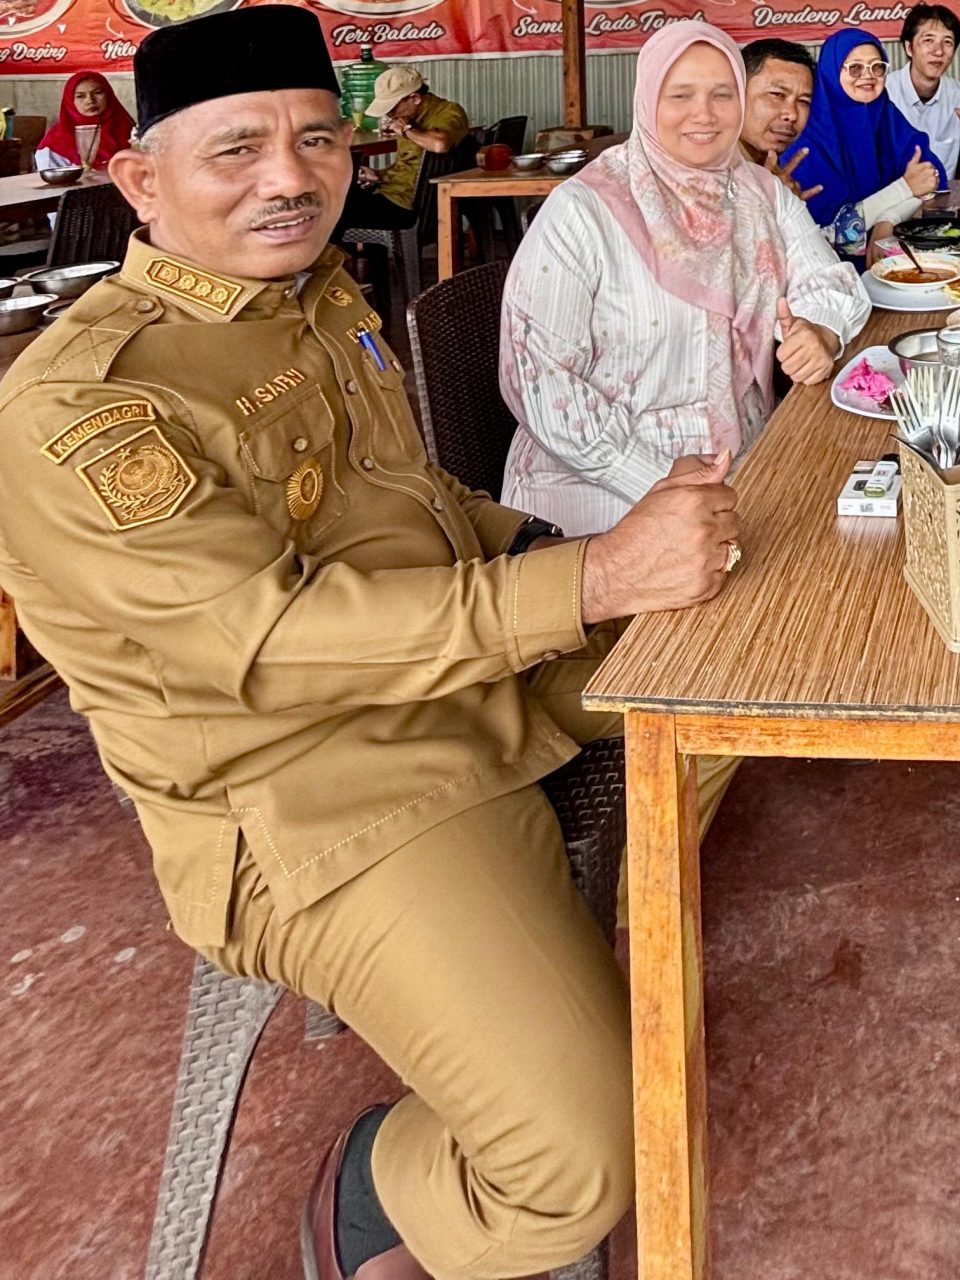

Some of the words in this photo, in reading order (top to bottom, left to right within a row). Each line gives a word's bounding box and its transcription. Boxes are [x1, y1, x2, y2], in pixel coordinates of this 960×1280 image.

[585, 13, 639, 35] Lado
[639, 9, 705, 32] Tan
[753, 6, 841, 27] Dendeng
[843, 2, 918, 24] Lambo
[332, 24, 372, 46] Teri
[373, 22, 445, 43] Balado
[12, 41, 68, 61] Daging
[53, 405, 144, 454] KEMENDAGRI
